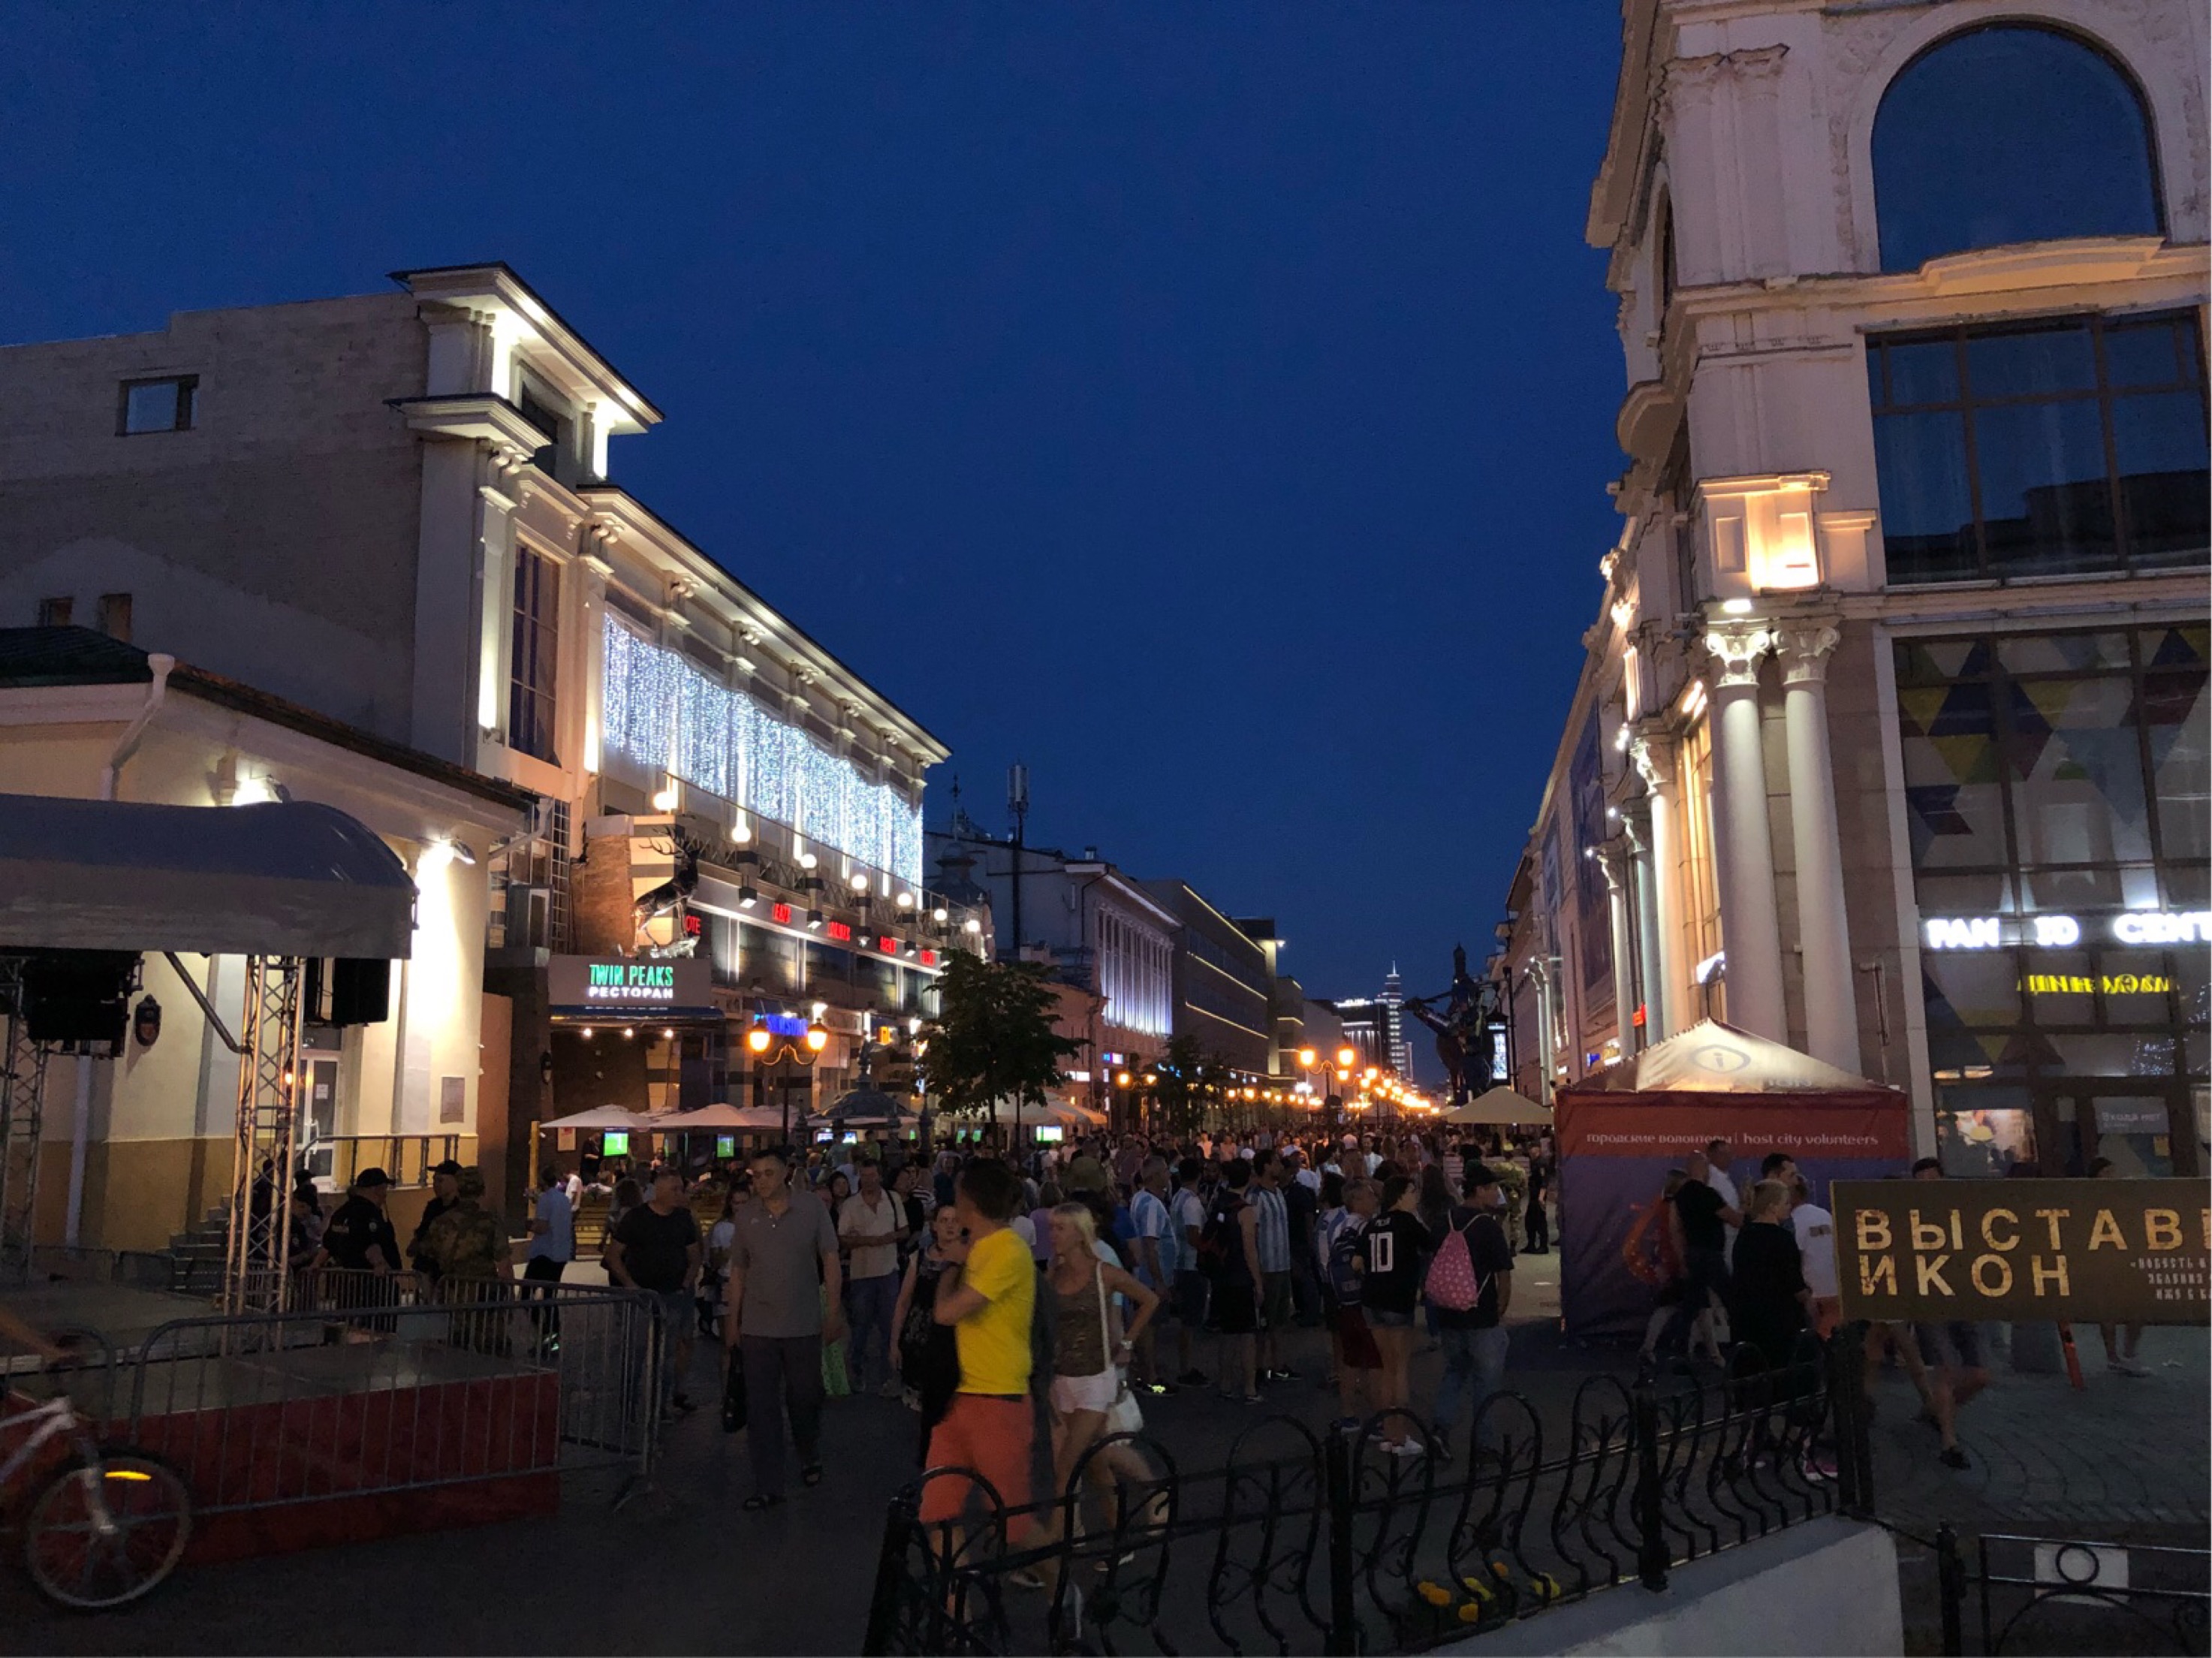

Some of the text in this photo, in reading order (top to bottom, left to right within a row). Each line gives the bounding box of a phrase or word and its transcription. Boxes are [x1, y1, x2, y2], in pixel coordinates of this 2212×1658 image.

[2036, 915, 2080, 946] ID
[589, 964, 674, 986] TWIN PEAKS
[589, 987, 674, 999] РЕСТОРАН
[1743, 1133, 1878, 1147] host city volunteers
[1369, 1231, 1393, 1273] 10
[1859, 1254, 2071, 1297] ИКОН
